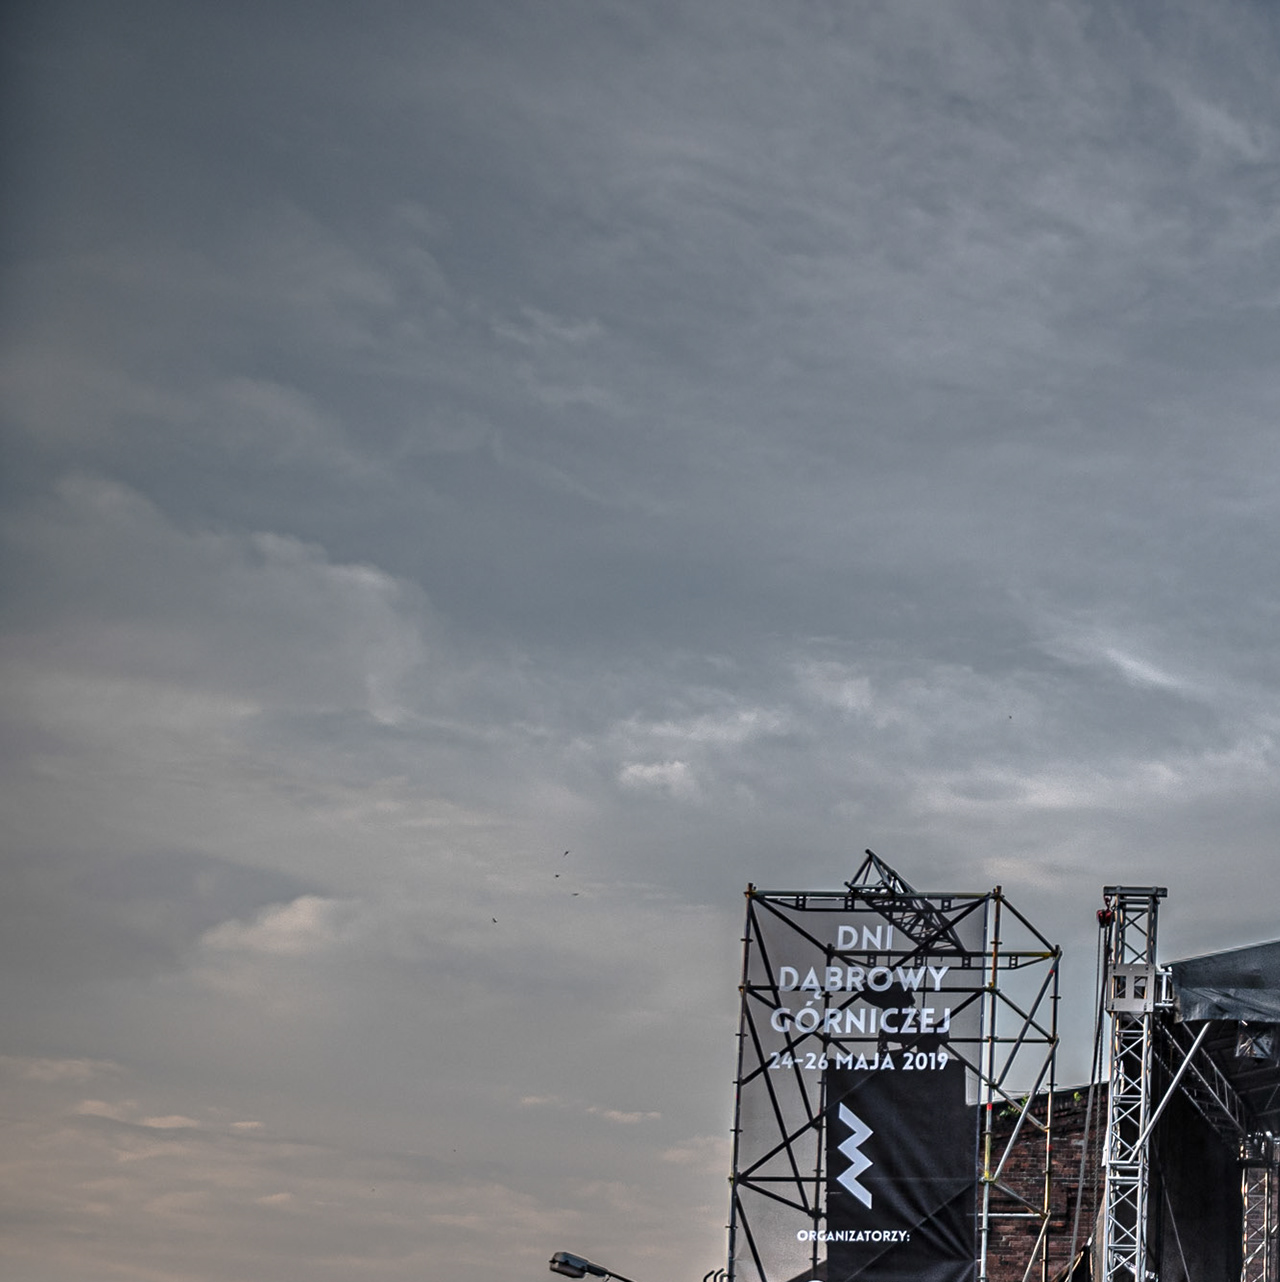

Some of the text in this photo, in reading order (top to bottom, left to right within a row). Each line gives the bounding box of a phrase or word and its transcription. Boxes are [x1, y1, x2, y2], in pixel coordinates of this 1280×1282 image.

[837, 925, 893, 950] DNI
[779, 966, 949, 1000] DĄBROWY
[770, 1001, 951, 1033] GÓRNICZEJ
[769, 1052, 948, 1070] 24-26 MAJA 2019
[797, 1230, 910, 1242] ORGANIZATORZY:
